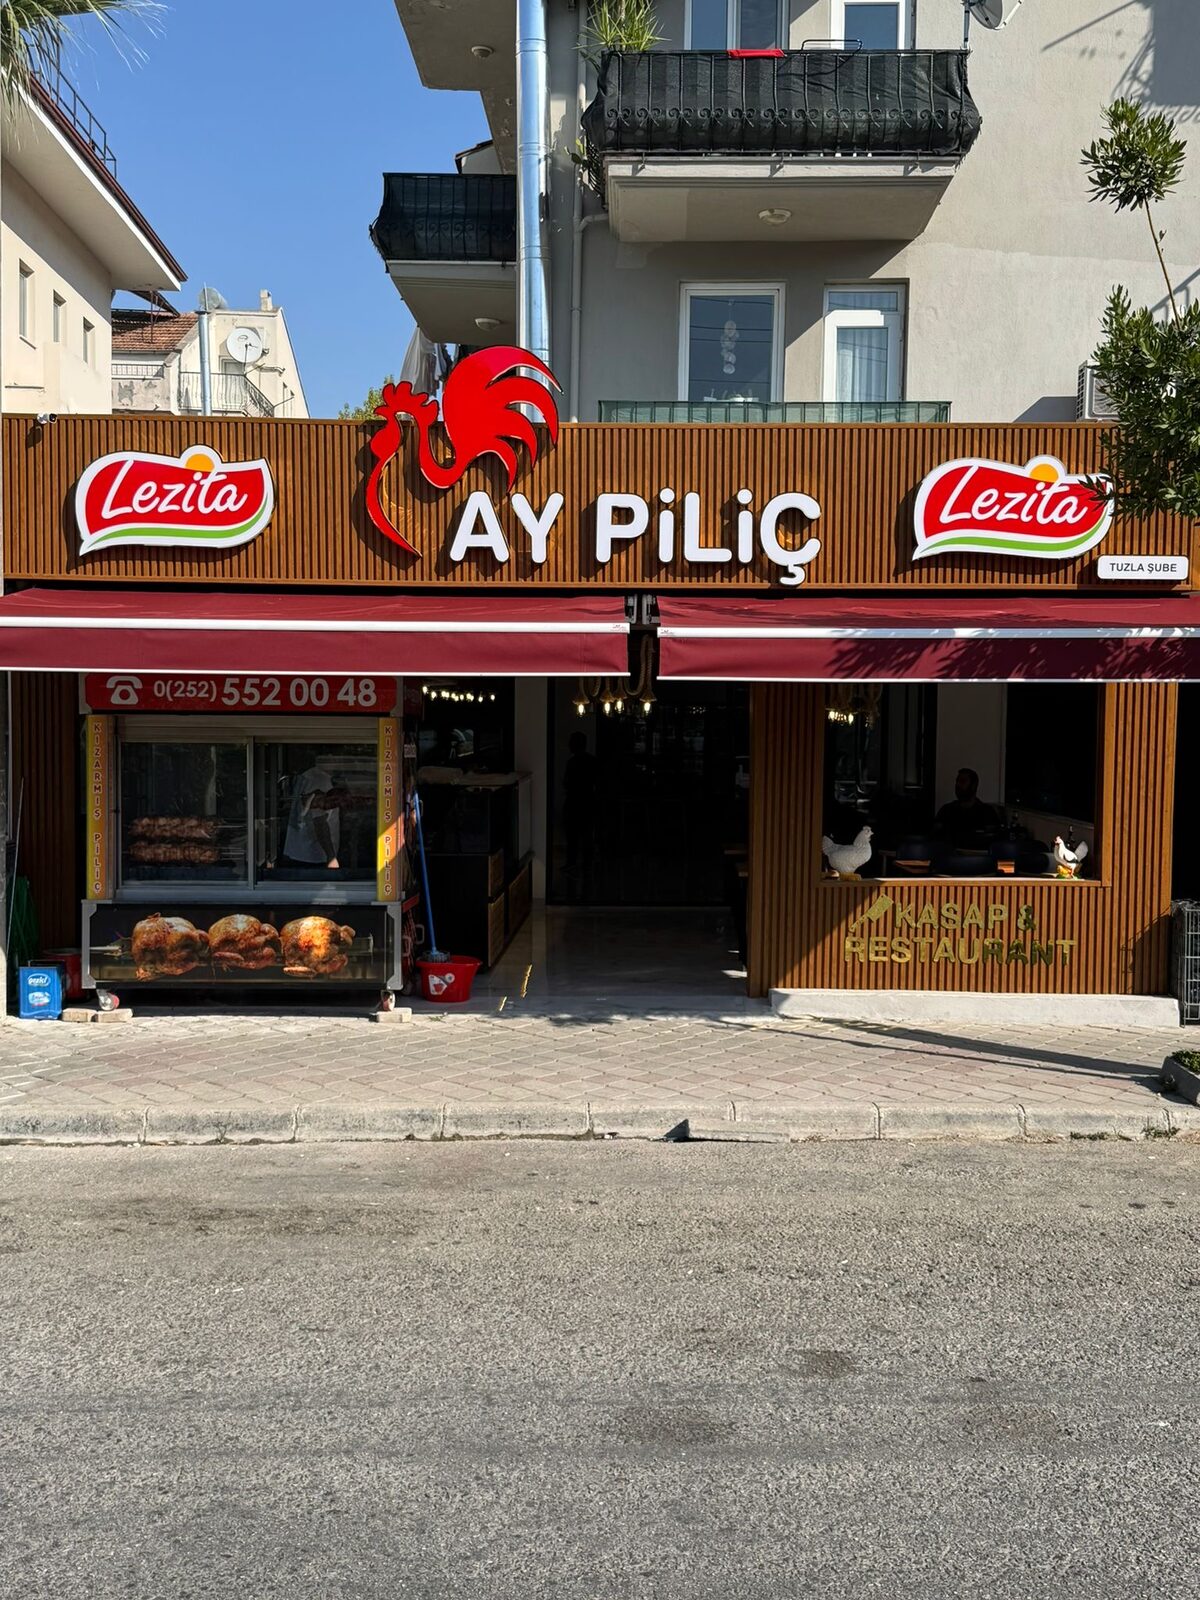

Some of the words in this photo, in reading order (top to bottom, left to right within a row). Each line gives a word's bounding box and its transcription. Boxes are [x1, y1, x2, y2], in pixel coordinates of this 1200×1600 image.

[101, 458, 248, 520] Lezita
[939, 465, 1088, 525] Lezita
[449, 491, 564, 564] AY
[1109, 563, 1145, 572] TUZLA
[1147, 563, 1178, 574] ŞUBE
[153, 680, 217, 702] 0(252)
[221, 677, 281, 706] 552
[289, 678, 329, 706] 00
[336, 678, 377, 707] 48
[93, 723, 102, 819] KIZARMIŞ
[383, 726, 392, 822] KIZARMIŞ
[894, 902, 1009, 930] KASAP
[1017, 904, 1037, 931] &
[844, 937, 1077, 965] RESTAURANT
